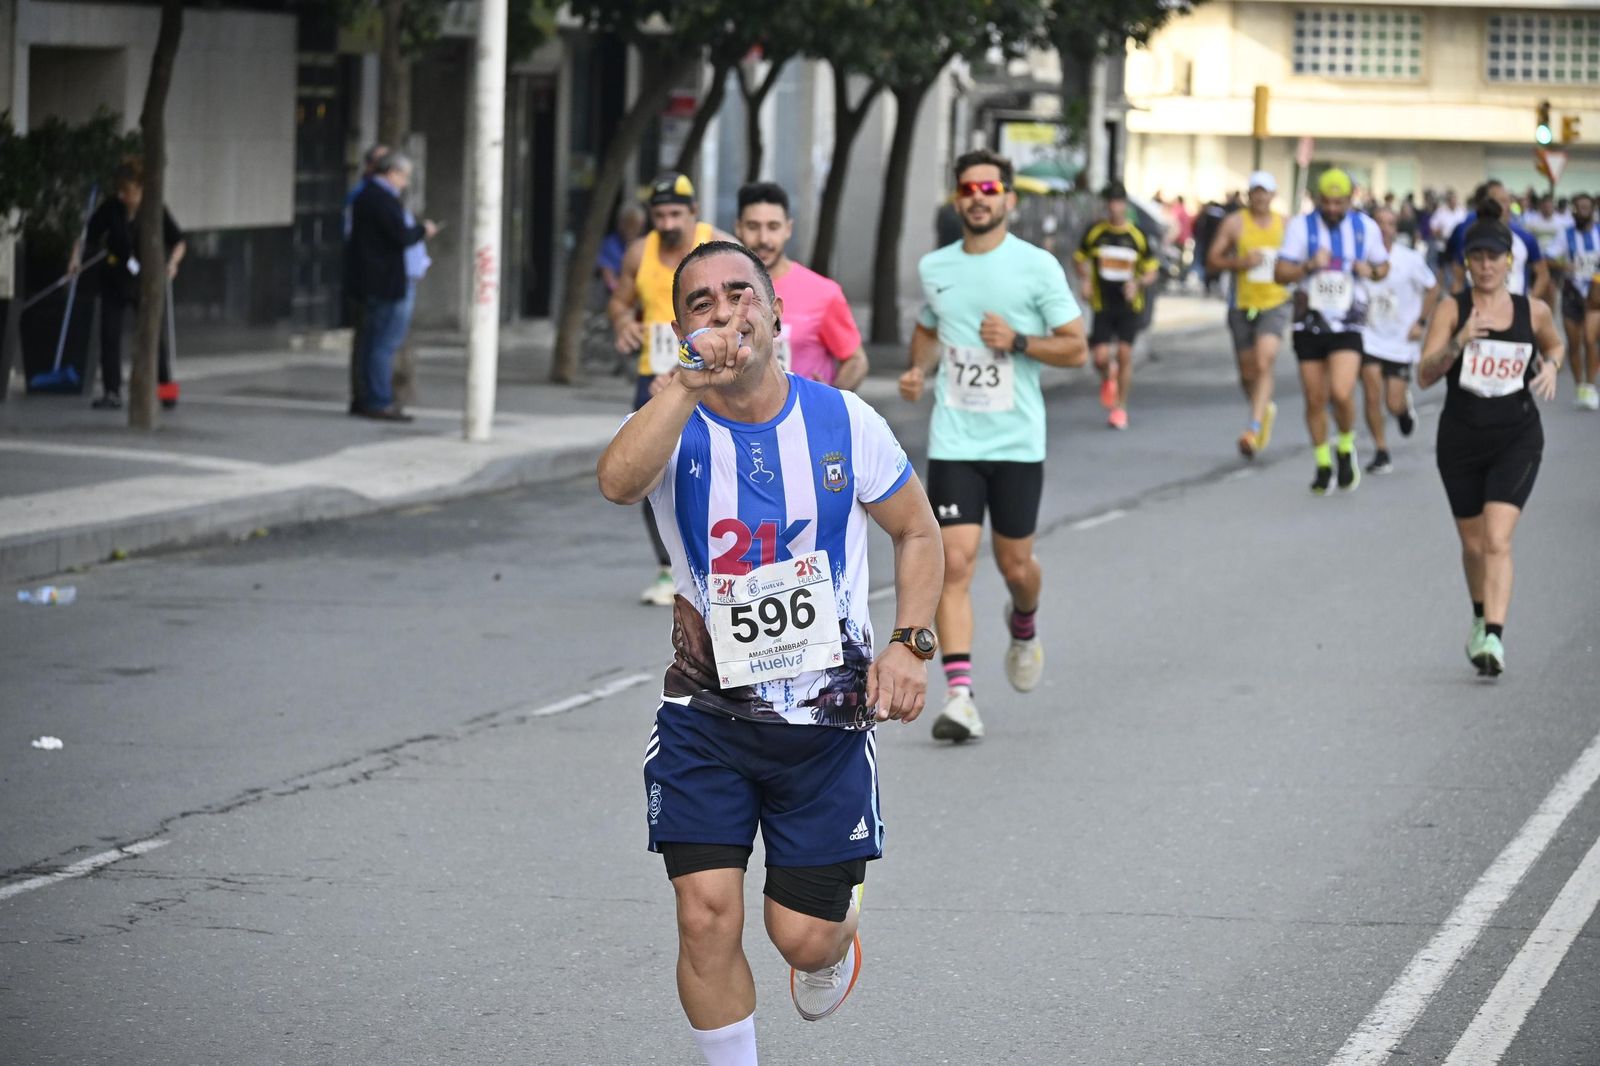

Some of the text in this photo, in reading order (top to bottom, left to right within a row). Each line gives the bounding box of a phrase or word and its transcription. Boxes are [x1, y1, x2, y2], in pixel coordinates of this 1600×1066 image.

[953, 362, 1000, 387] 723
[1471, 356, 1524, 379] 1059
[711, 518, 813, 576] 21K
[761, 581, 785, 591] HUELVA
[731, 588, 816, 643] 596
[774, 638, 809, 653] ZAMBRANO
[749, 653, 804, 674] Huelva
[849, 830, 869, 841] adidas
